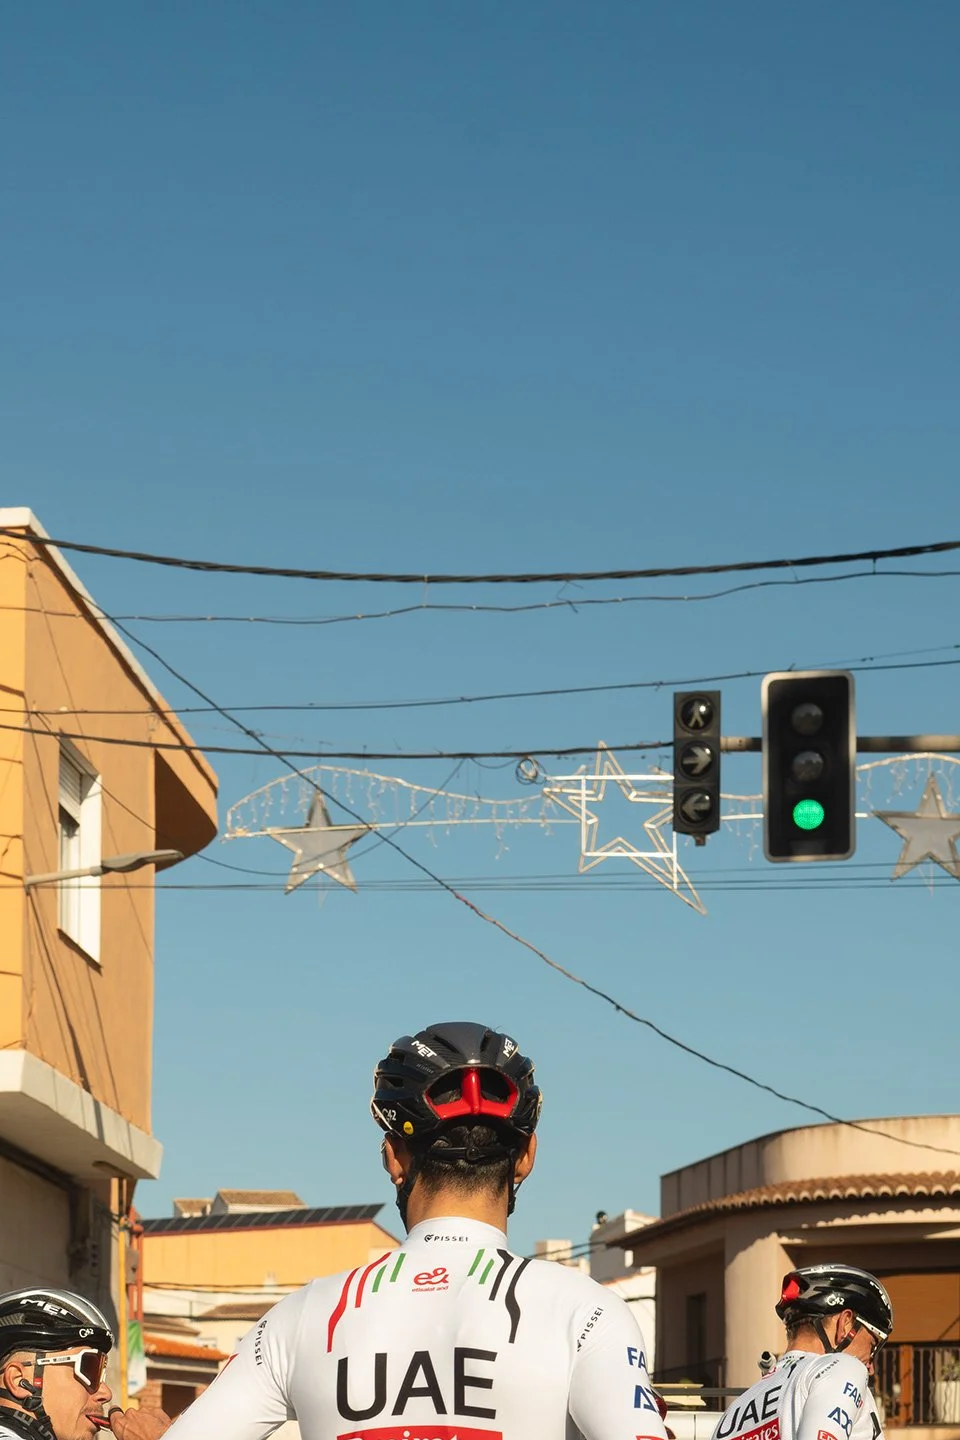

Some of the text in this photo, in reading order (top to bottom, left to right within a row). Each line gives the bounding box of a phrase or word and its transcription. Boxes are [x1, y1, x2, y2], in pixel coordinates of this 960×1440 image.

[411, 1040, 437, 1058] MET
[503, 1038, 515, 1057] MET
[580, 1307, 604, 1340] PISSEI
[254, 1330, 262, 1366] PISSEI
[337, 1347, 498, 1421] UAE
[716, 1384, 783, 1440] UAE
